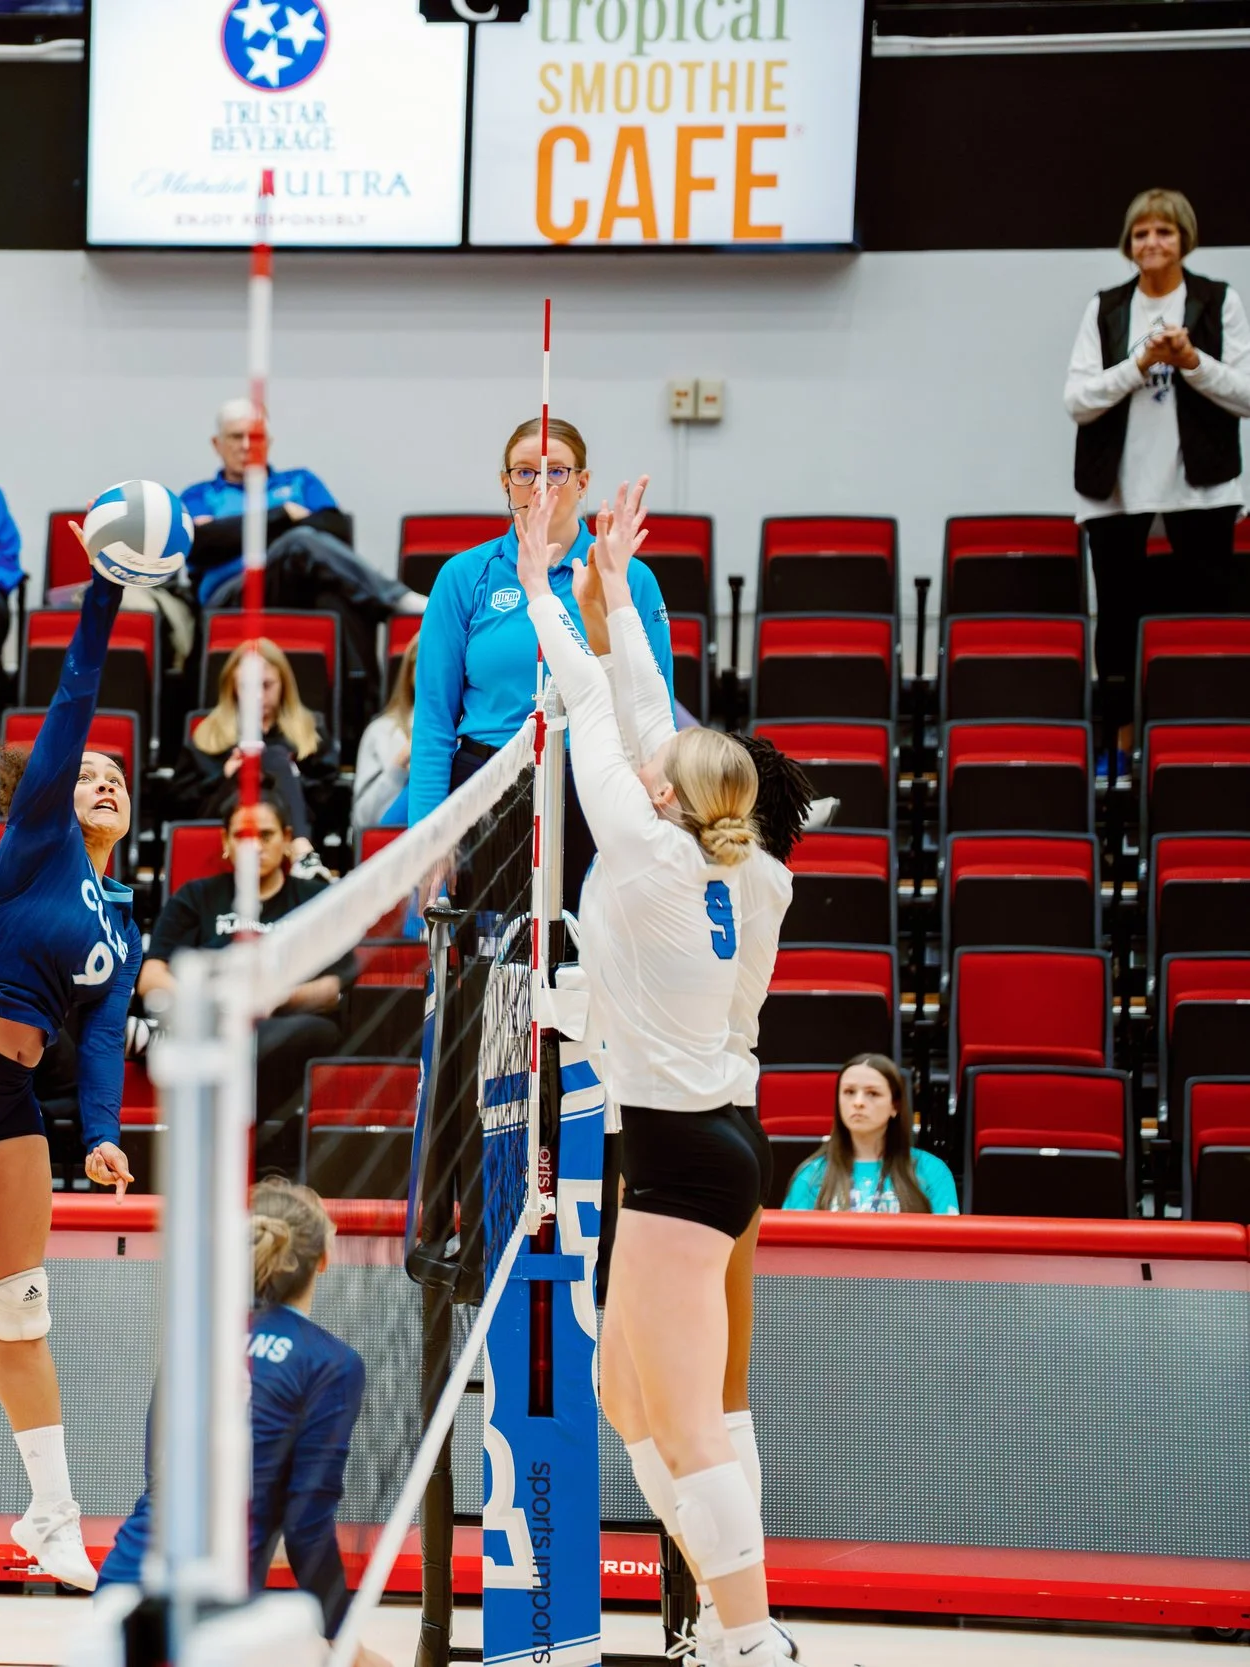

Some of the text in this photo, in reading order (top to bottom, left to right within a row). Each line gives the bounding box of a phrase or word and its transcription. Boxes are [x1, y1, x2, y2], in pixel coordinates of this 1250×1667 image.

[538, 0, 792, 56] tropical
[537, 60, 789, 114] SMOOTHIE
[221, 100, 327, 124] TRI STAR
[210, 127, 336, 151] BEVERAGE
[284, 170, 412, 198] ULTRA
[535, 124, 787, 244] CAFE
[174, 213, 234, 226] ENJOY
[704, 880, 737, 960] 9
[71, 941, 115, 985] 9
[538, 1145, 553, 1188] orts
[22, 1292, 43, 1303] adidas
[244, 1333, 294, 1363] NS
[526, 1461, 555, 1665] sports imports
